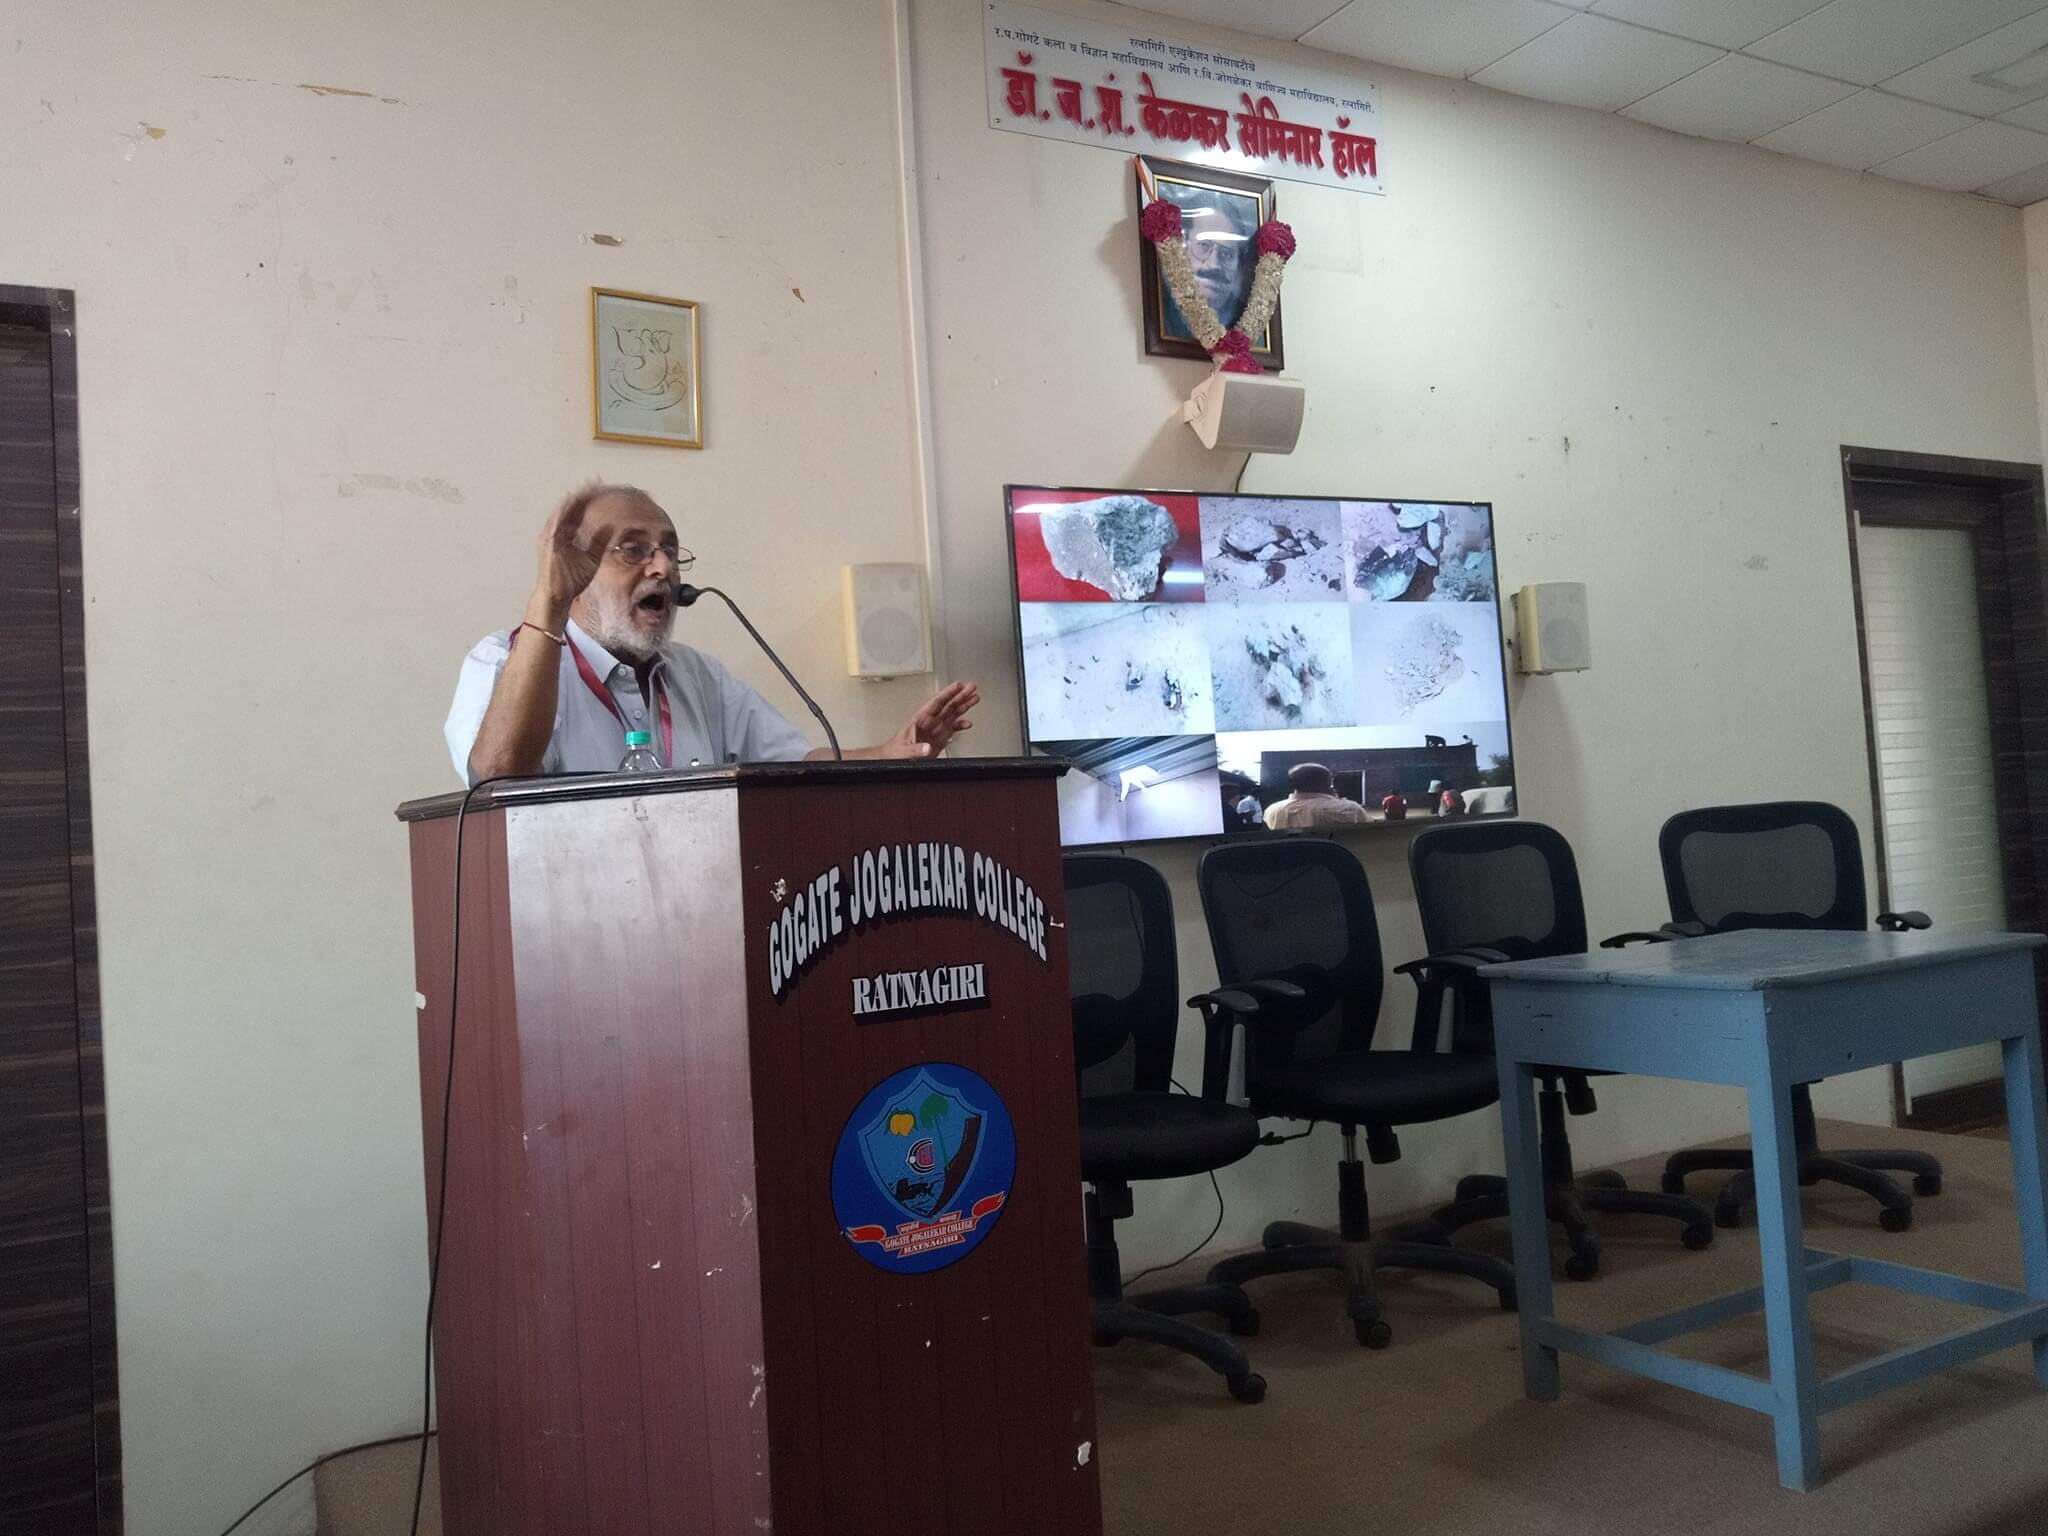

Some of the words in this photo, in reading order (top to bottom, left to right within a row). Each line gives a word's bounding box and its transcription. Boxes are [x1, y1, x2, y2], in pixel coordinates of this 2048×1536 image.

[1043, 37, 1065, 50] कला
[1069, 42, 1077, 53] व
[1081, 42, 1108, 59] विज्ञान
[1112, 50, 1164, 70] महाविद्यालय
[1168, 62, 1191, 76] आणि
[1328, 115, 1378, 179] हॉल
[768, 866, 843, 996] GOGATE
[850, 842, 969, 926] JOGALEKAR
[972, 851, 1048, 963] COLLEGE
[851, 963, 986, 1016] RATNAGIRI
[903, 1233, 959, 1254] RATNAGIRI
[947, 1220, 974, 1233] COLLEGE
